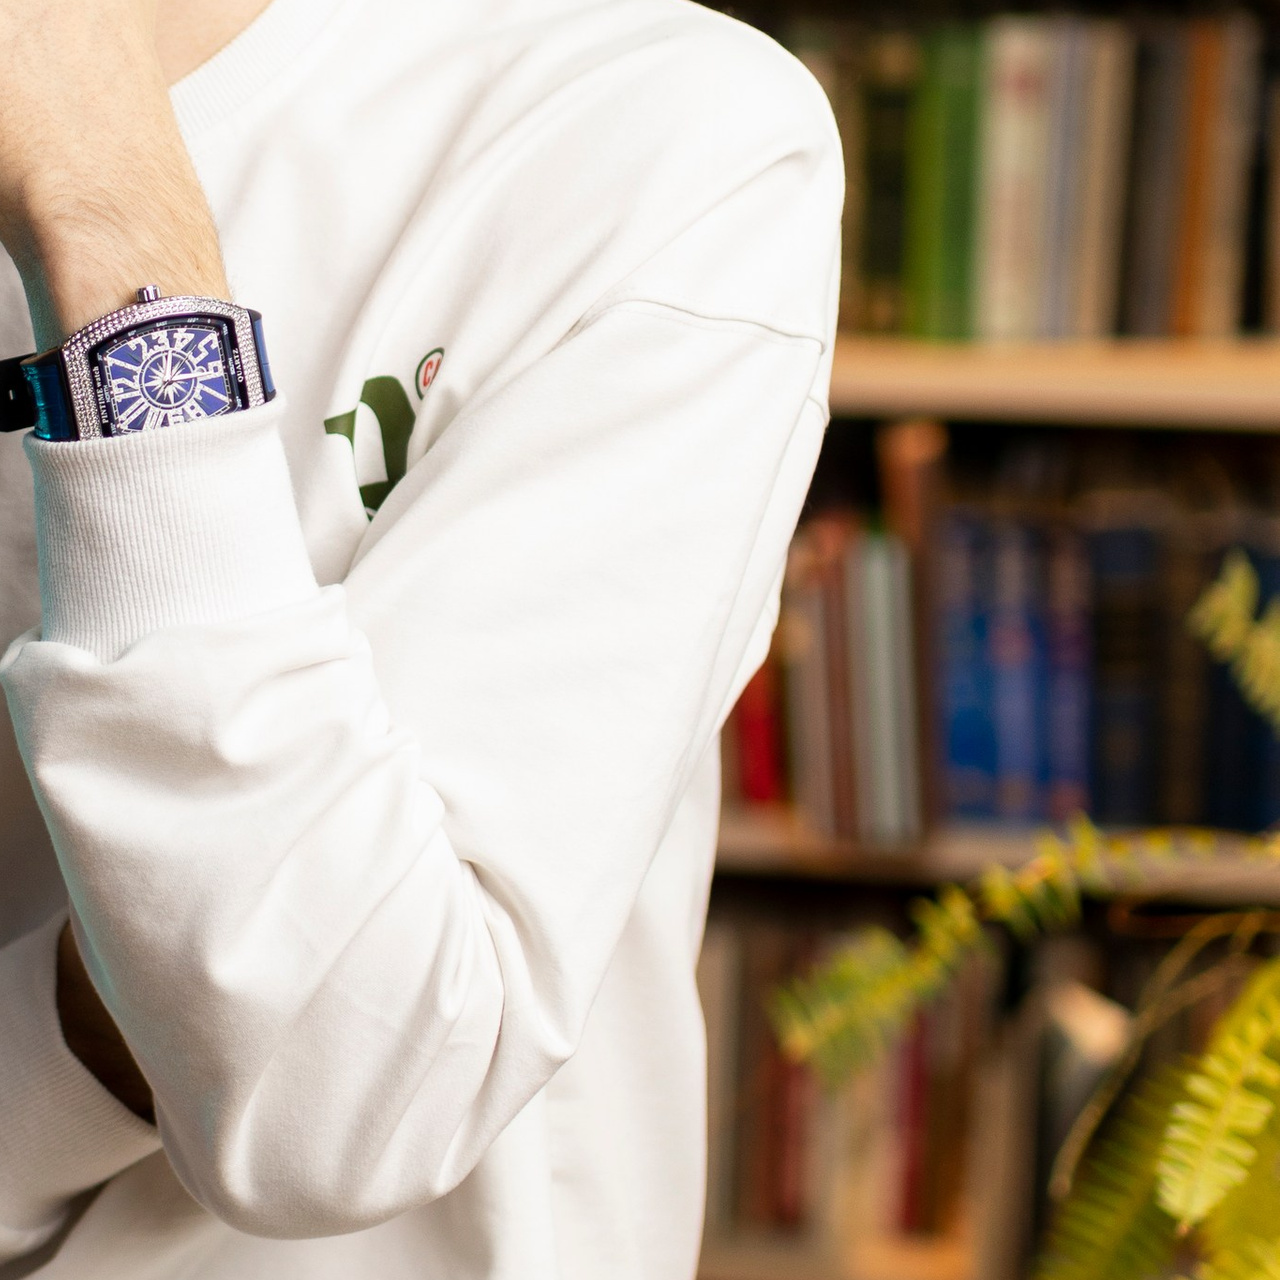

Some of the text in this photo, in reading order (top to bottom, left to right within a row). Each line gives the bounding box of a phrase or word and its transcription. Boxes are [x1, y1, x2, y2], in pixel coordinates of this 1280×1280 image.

[127, 336, 154, 362] 2
[151, 330, 170, 350] 3
[173, 329, 195, 350] 4
[189, 332, 218, 365] 5
[92, 365, 102, 387] watch
[233, 347, 244, 383] QUARTZ
[103, 384, 111, 403] NORTH
[111, 375, 142, 402] 12
[195, 381, 230, 404] 7
[96, 386, 109, 424] PINTIME
[119, 397, 151, 428] 11
